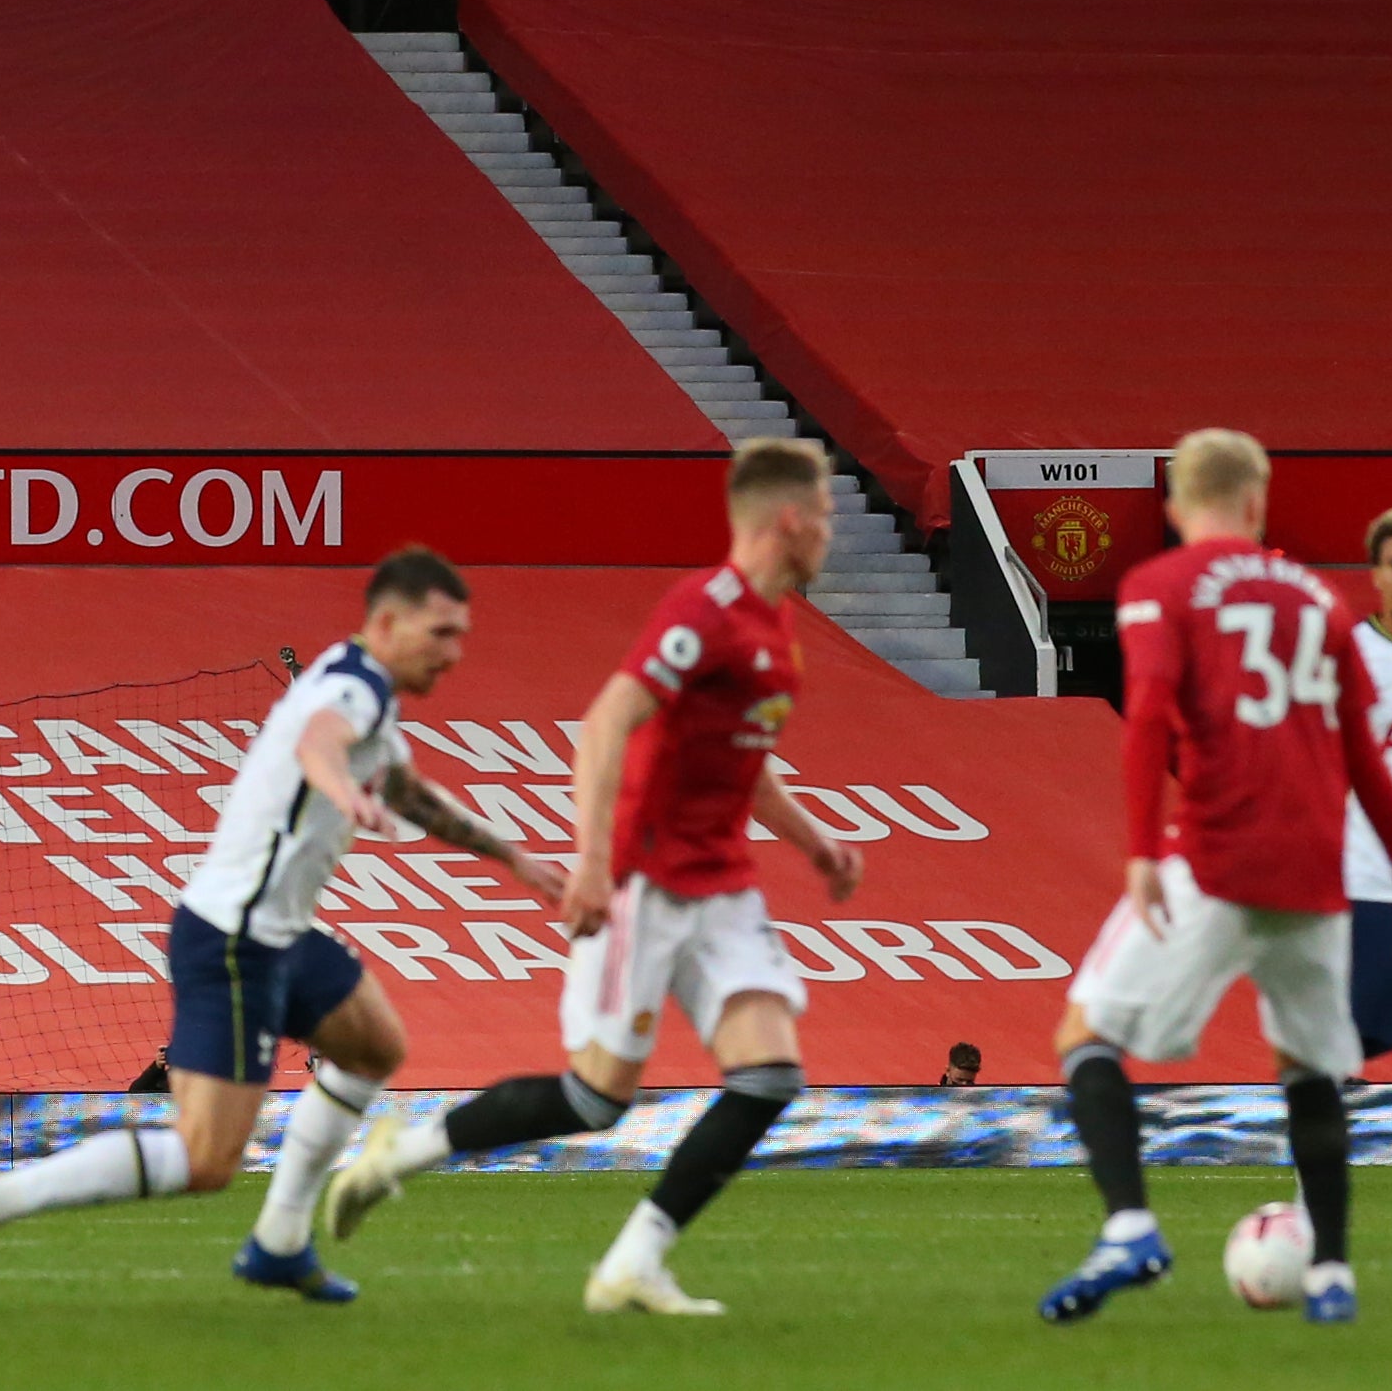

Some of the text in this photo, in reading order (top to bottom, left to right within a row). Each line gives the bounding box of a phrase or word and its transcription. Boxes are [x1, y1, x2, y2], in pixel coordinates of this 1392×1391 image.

[1040, 463, 1098, 482] W101
[1039, 501, 1104, 529] MANCHESTER
[1050, 560, 1096, 576] UNITED
[1217, 603, 1342, 730] 34
[745, 784, 991, 842] OU
[43, 853, 544, 912] HME
